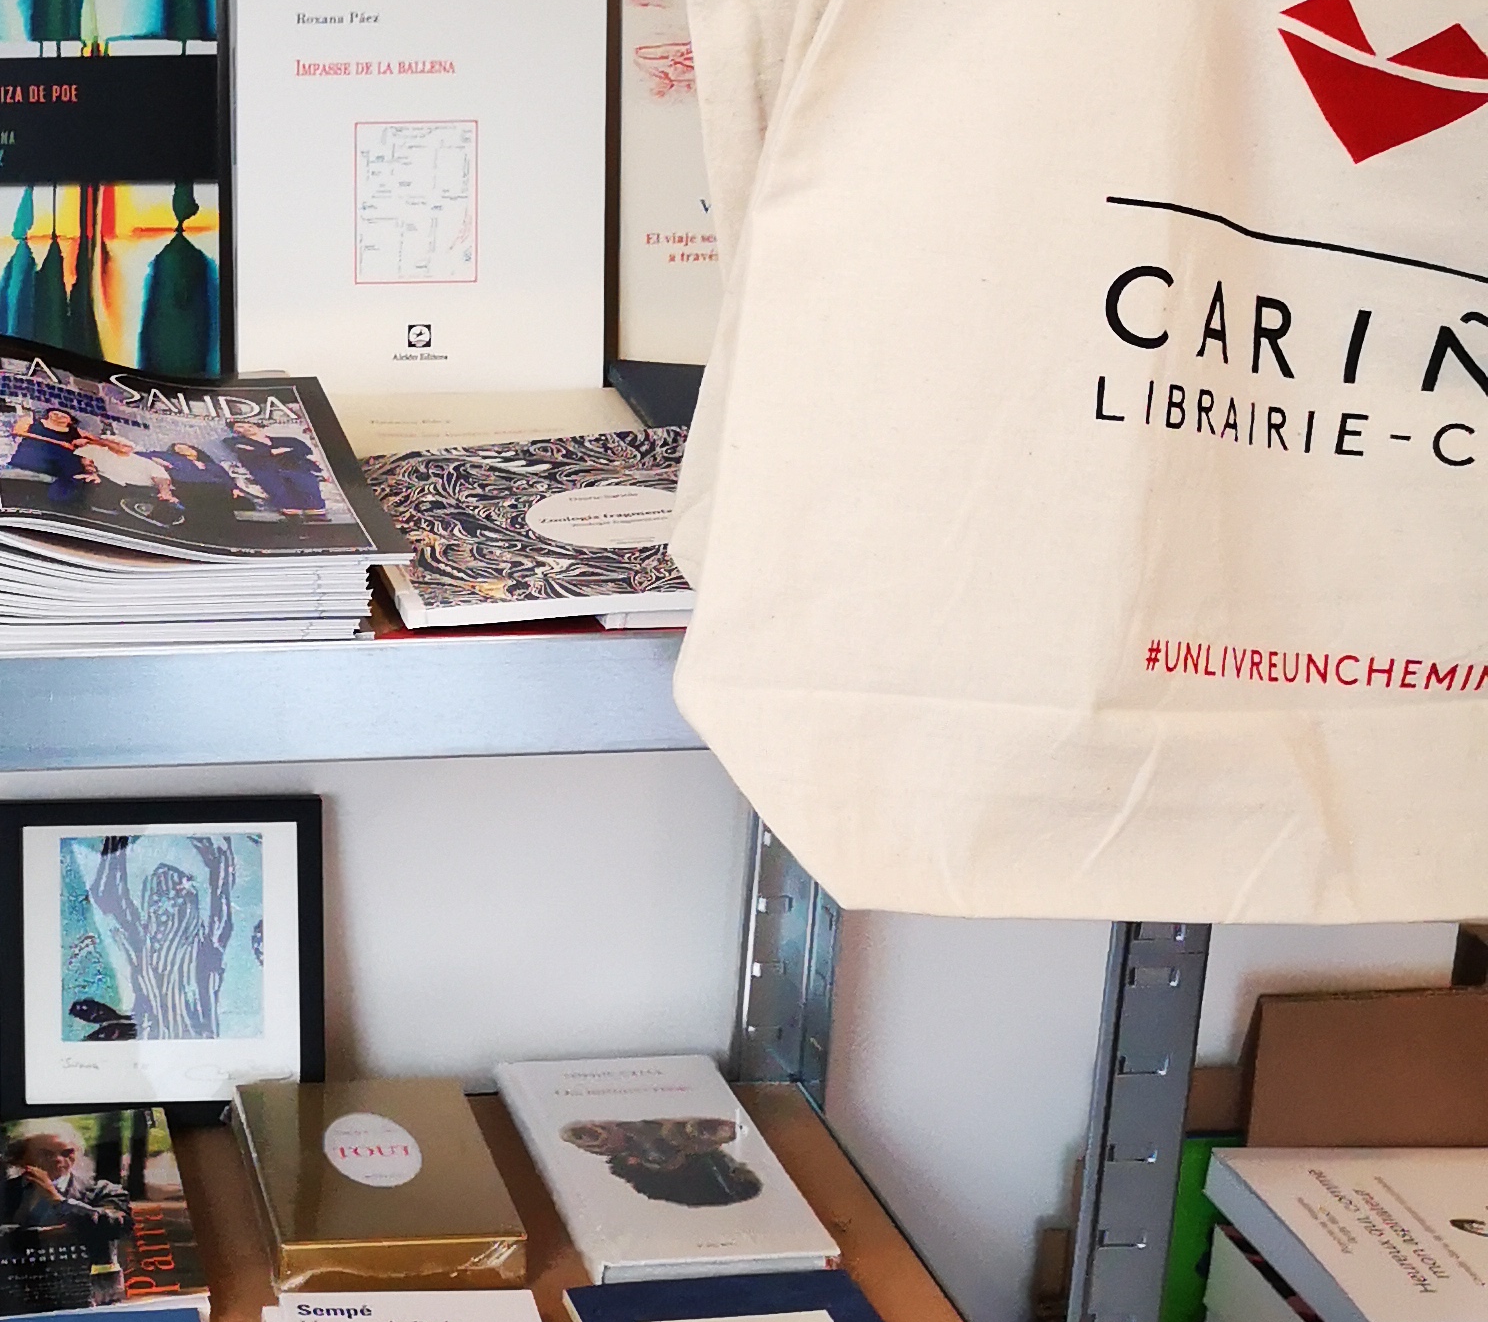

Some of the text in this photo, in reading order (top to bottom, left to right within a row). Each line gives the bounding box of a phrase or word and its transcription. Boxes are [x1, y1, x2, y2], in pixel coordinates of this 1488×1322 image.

[296, 12, 345, 25] Roxana
[29, 85, 47, 103] DE
[52, 84, 79, 103] POE
[645, 231, 697, 247] El viaje
[109, 372, 301, 422] SALIDA
[1378, 1237, 1438, 1294] Heureux
[1412, 1244, 1451, 1280] mon
[296, 1303, 373, 1318] Sempé
